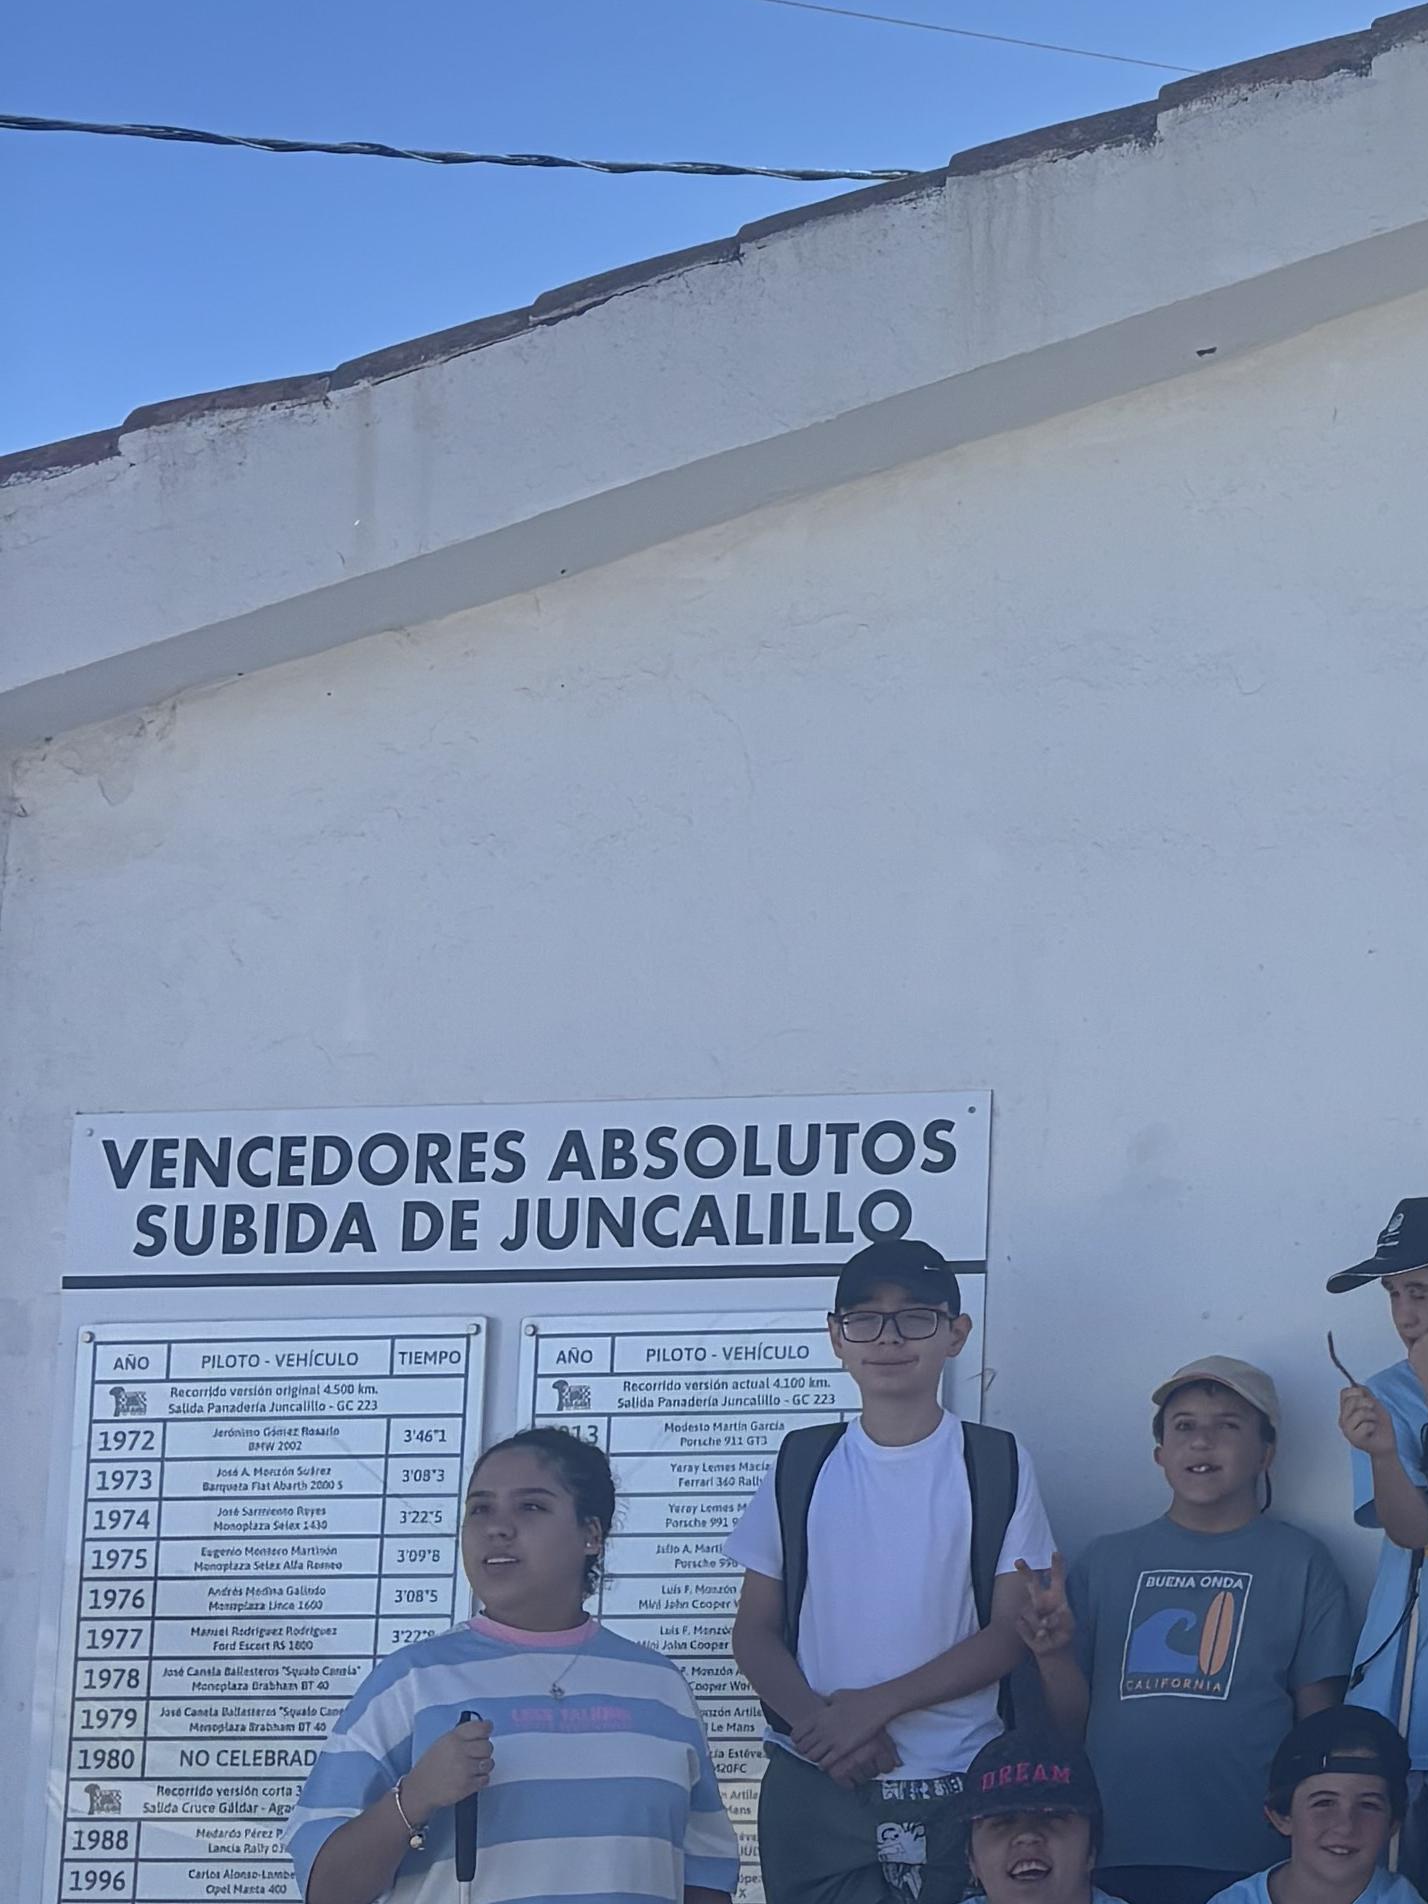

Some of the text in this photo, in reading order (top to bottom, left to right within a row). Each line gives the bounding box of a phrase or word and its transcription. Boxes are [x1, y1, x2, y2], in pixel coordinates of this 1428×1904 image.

[102, 1117, 959, 1191] VENCEDORES ABSOLUTOS
[131, 1187, 915, 1260] SUBIDA DE JUNCALILLO
[201, 1349, 359, 1370] PILOTO VEHÍCULO
[399, 1351, 461, 1366] TIEMPO
[556, 1348, 593, 1364] AÑO
[646, 1343, 809, 1362] PILOTO VEHÍCULO
[113, 1355, 150, 1371] AÑO
[170, 1383, 378, 1400] Recorrido versión original km.
[623, 1377, 830, 1392] Recorrido versión actual km.
[169, 1400, 377, 1414] Salida Panadería Juncalillo GC 223
[617, 1394, 835, 1409] Salida Panadería Juncalillo GC 223
[98, 1430, 155, 1452] 1972
[95, 1470, 152, 1492] 1973
[92, 1509, 150, 1531] 1974
[91, 1548, 148, 1570] 1975
[1146, 1576, 1243, 1589] BUENA ONDA
[89, 1589, 146, 1610] 1976
[86, 1628, 143, 1649] 1977
[84, 1668, 140, 1689] 1978
[1126, 1678, 1221, 1692] CALIFORNIA
[81, 1709, 138, 1730] 1979
[77, 1749, 134, 1769] 1980
[180, 1748, 317, 1766] NO CELEBRAD
[981, 1762, 1071, 1792] DREAM
[156, 1785, 293, 1797] Recorrido versión corta
[143, 1803, 179, 1814] Salida
[72, 1830, 129, 1850] 1988
[70, 1871, 125, 1891] 1996
